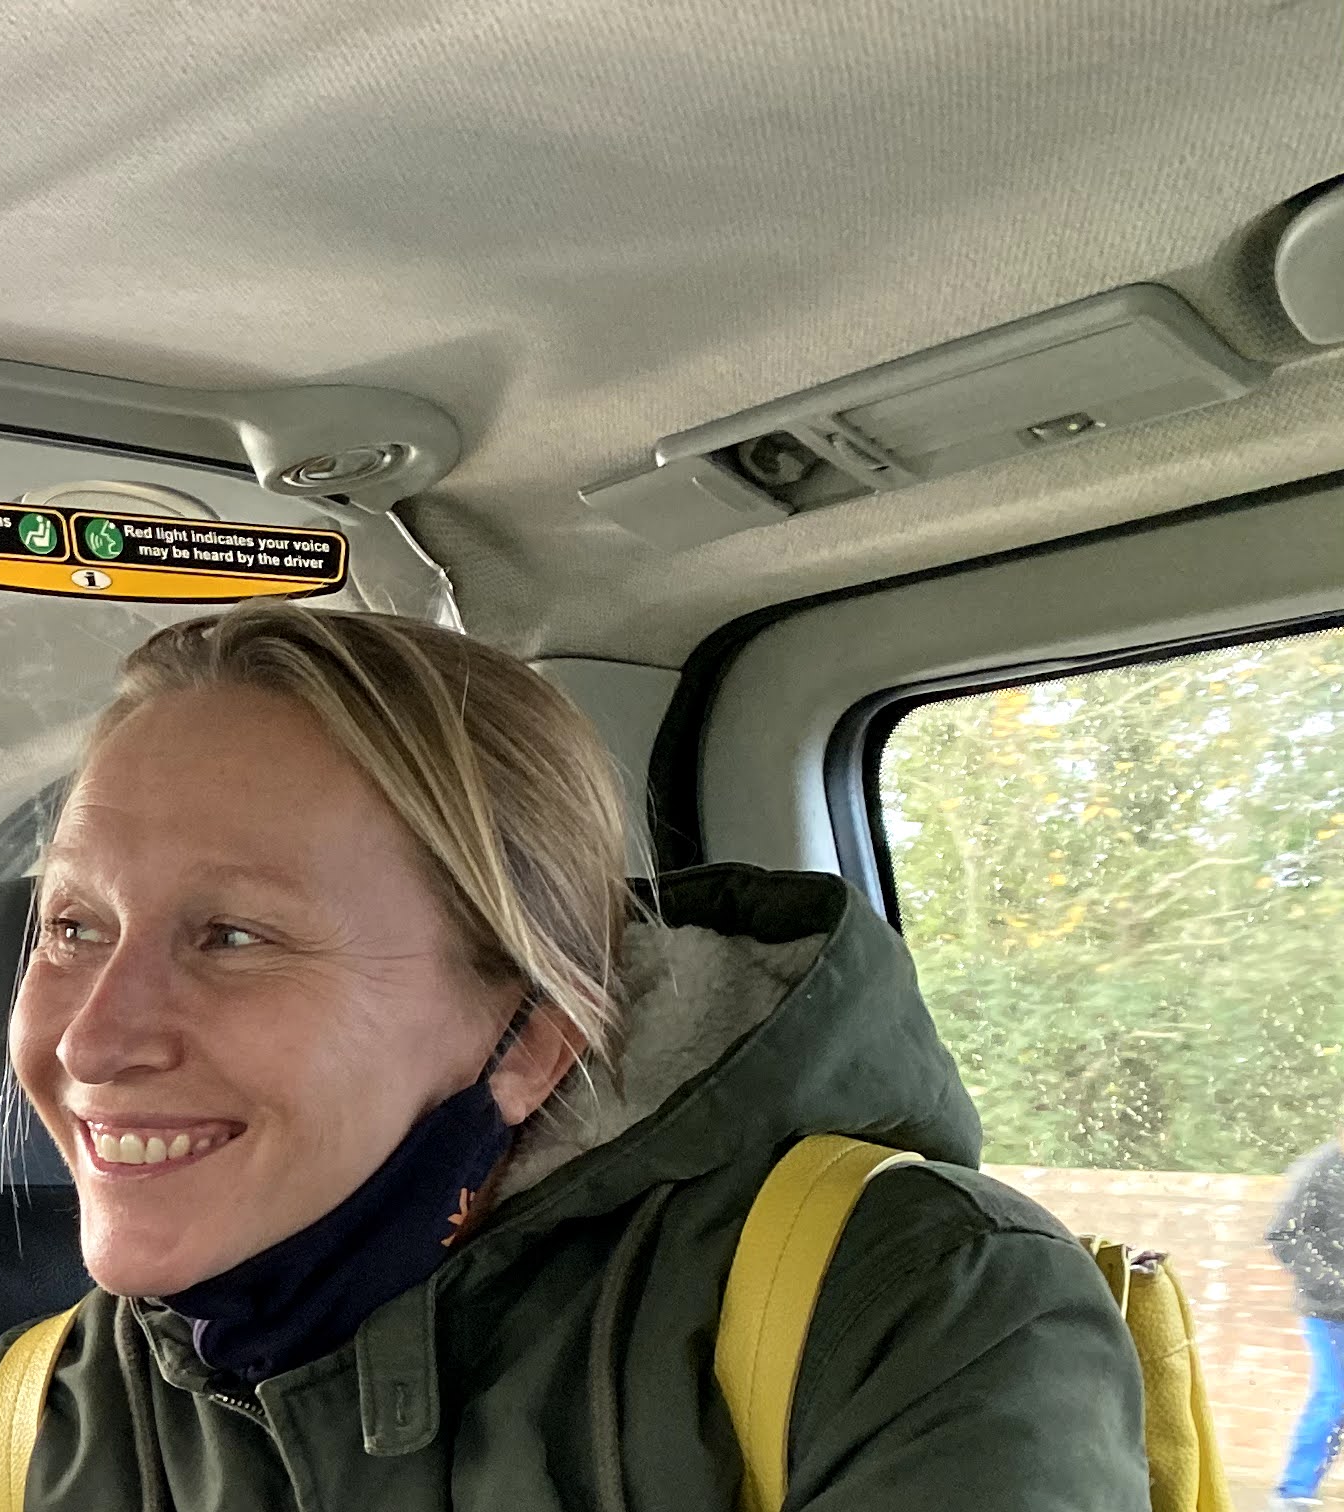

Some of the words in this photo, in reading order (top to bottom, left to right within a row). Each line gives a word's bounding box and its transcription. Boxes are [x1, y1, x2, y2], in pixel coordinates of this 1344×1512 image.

[123, 524, 153, 539] Red
[156, 527, 188, 543] light
[191, 529, 255, 547] indicates
[258, 537, 289, 552] your
[293, 539, 330, 553] voice
[138, 545, 169, 558] may
[173, 545, 190, 559] be
[194, 547, 234, 563] heard
[237, 550, 255, 567] by
[258, 552, 280, 567] the
[283, 553, 324, 569] driver
